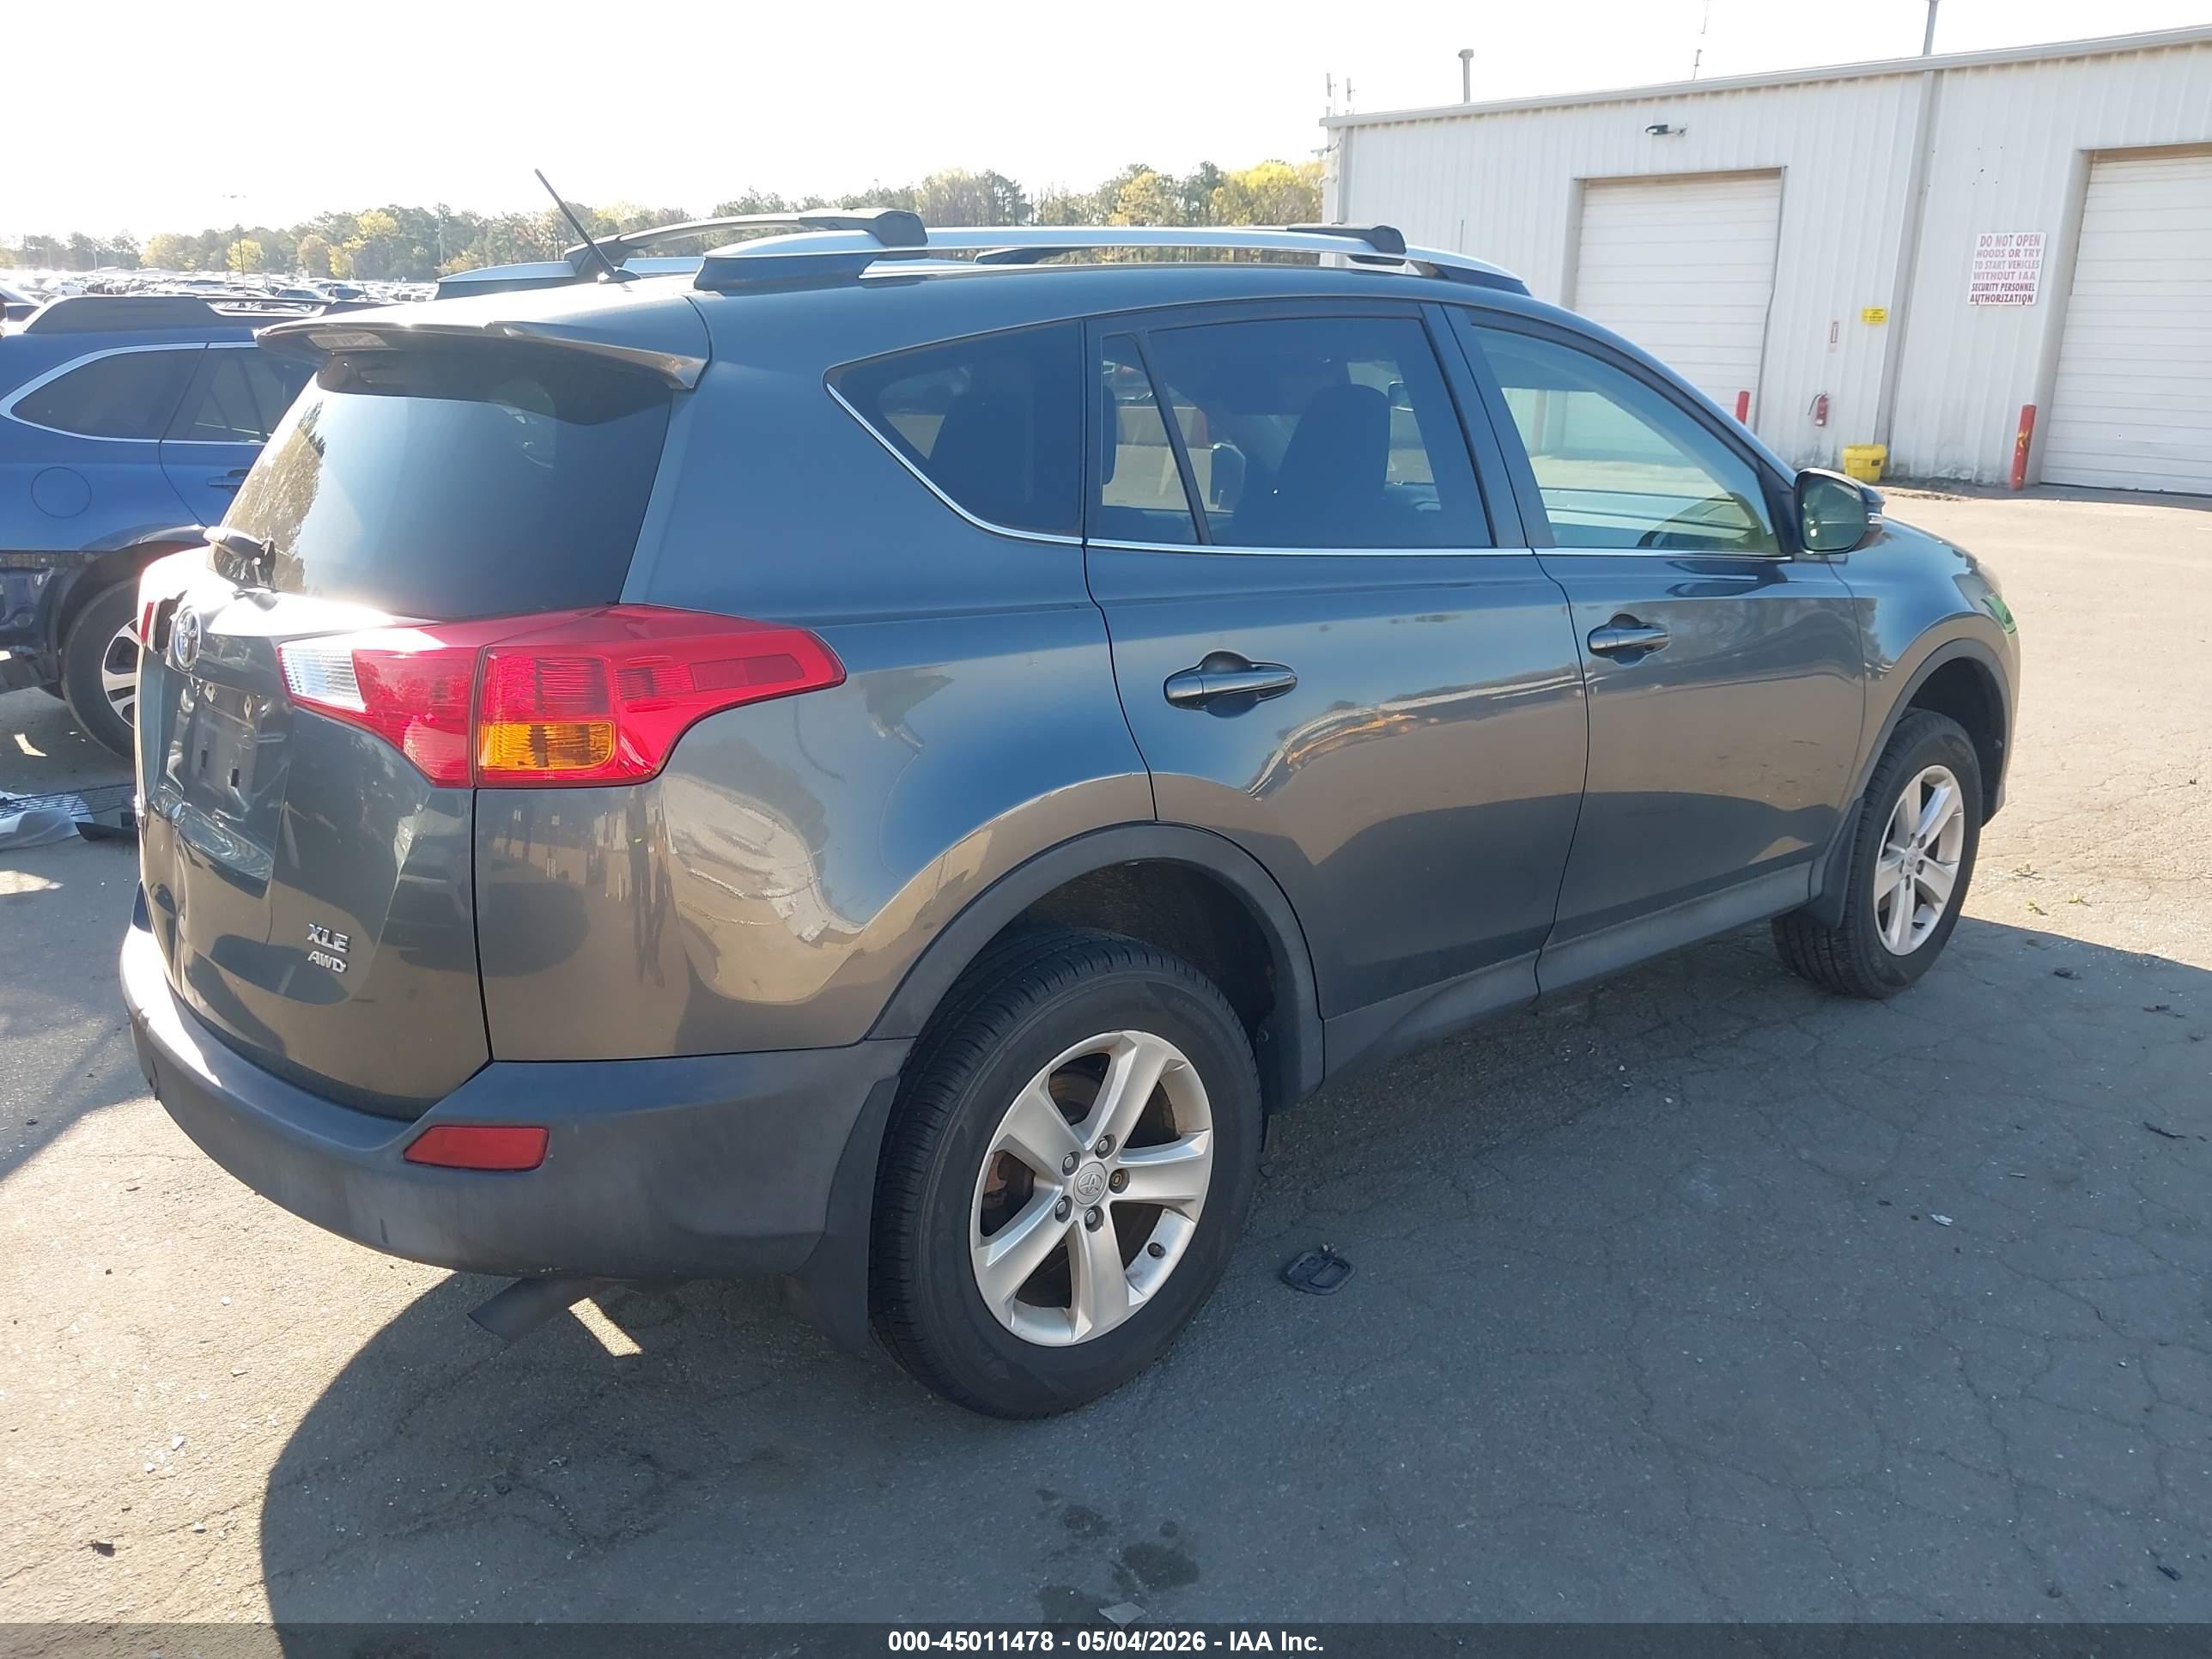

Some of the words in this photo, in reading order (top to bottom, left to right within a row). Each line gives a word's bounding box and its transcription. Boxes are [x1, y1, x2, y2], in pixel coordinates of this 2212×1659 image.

[1980, 235, 1993, 247] DO
[1995, 234, 2014, 246] NOT
[2016, 234, 2041, 246] OPEN
[1977, 249, 2006, 258] HOODS
[2008, 249, 2021, 258] OR
[2024, 249, 2041, 258] TRY
[1975, 260, 1983, 270] TO
[1984, 260, 2006, 269] START
[2008, 260, 2040, 269] VEHICLES
[1974, 271, 2016, 280] WITHOUT
[1972, 283, 1999, 292] SECURITY
[2000, 283, 2035, 292] PERSONNEL
[1970, 294, 2033, 303] AUTHORIZATION
[307, 923, 349, 953] XLE
[307, 951, 347, 973] AWD
